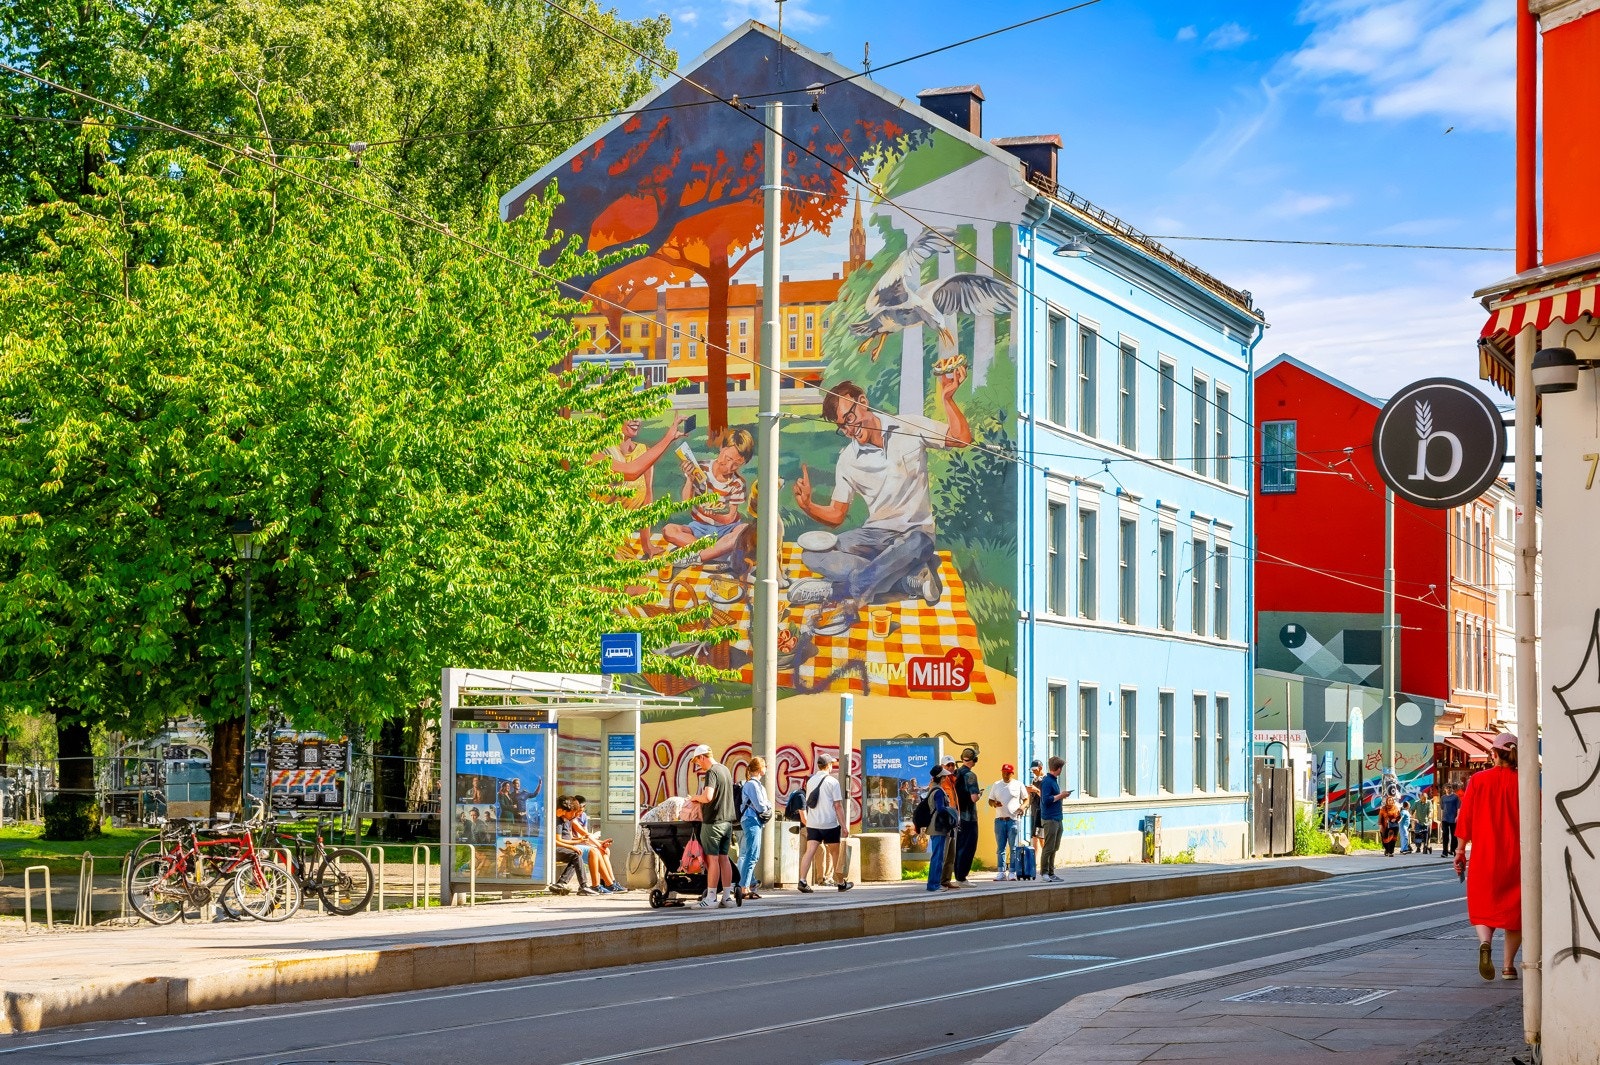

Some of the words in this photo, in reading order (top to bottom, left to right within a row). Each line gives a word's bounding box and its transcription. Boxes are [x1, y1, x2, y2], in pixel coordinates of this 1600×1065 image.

[912, 661, 965, 687] Mills
[510, 746, 536, 757] prime
[465, 757, 483, 765] DET
[484, 757, 502, 765] HER
[908, 754, 928, 762] prime
